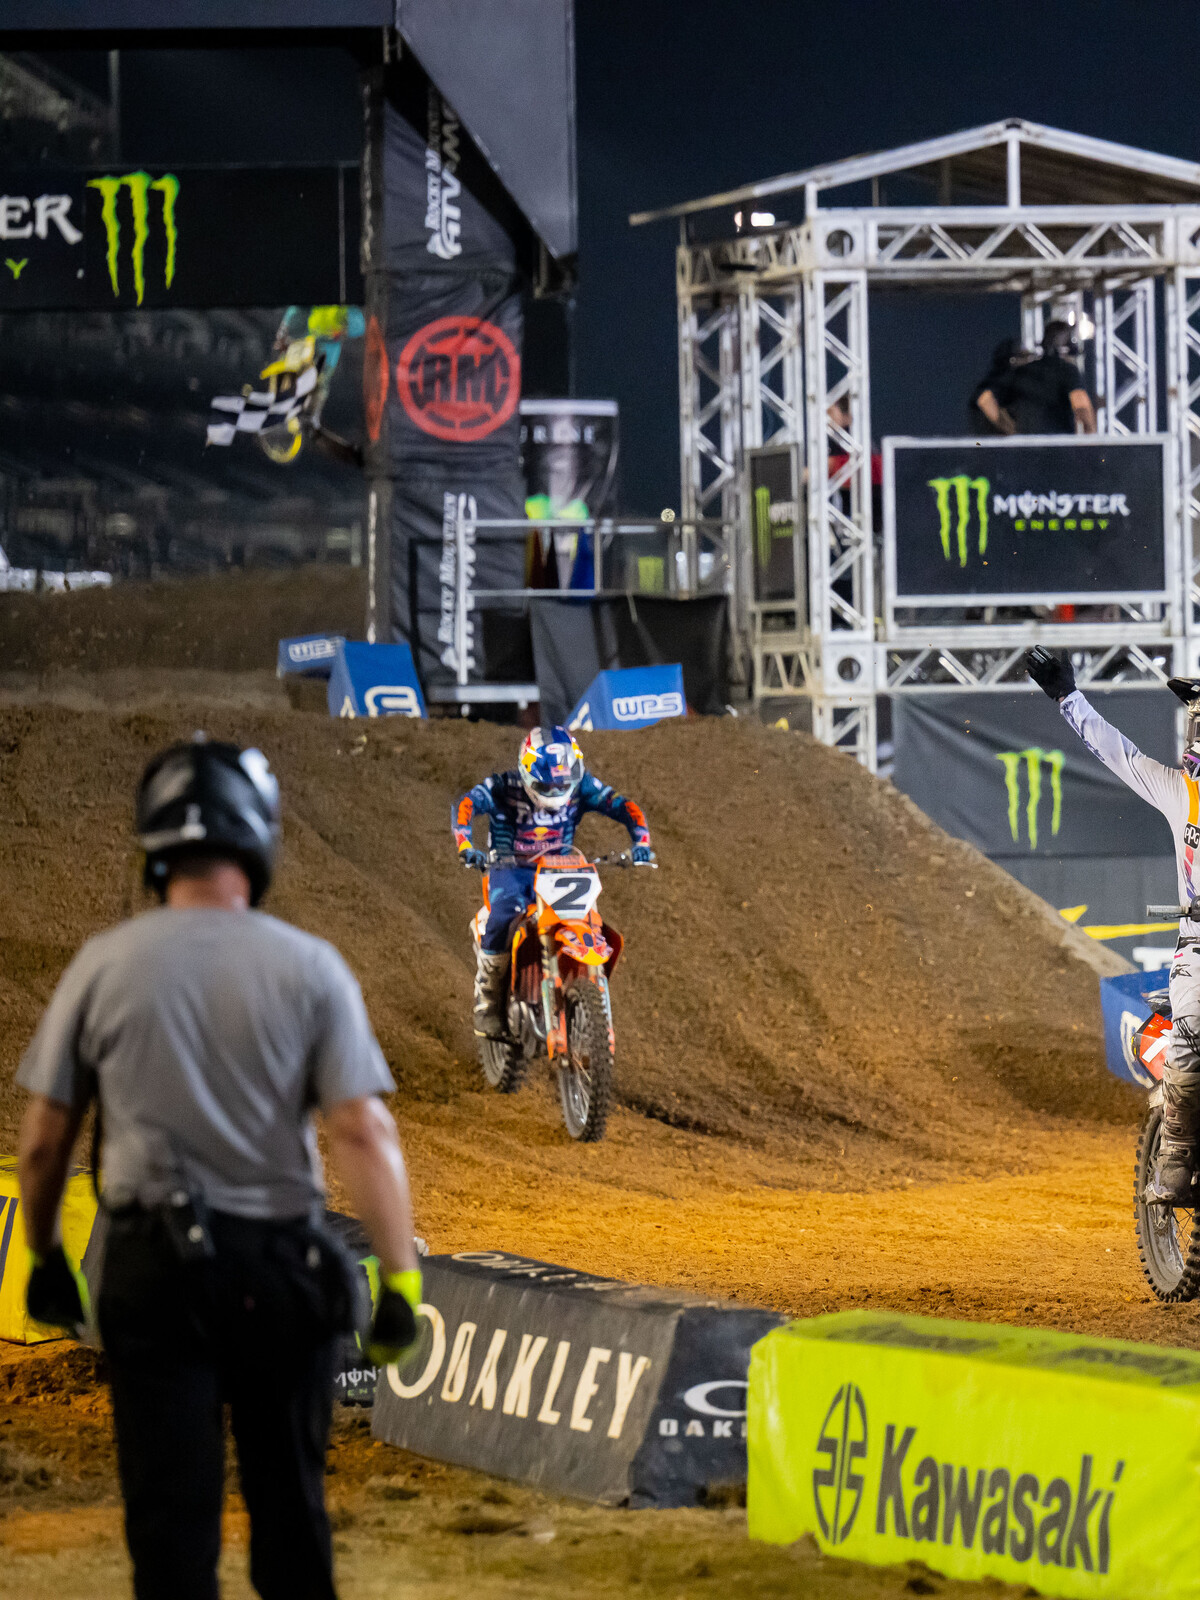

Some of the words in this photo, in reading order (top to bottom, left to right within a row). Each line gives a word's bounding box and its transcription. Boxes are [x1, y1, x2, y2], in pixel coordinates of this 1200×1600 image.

[993, 490, 1131, 518] MONSTER
[612, 691, 684, 722] WPS
[1184, 826, 1200, 845] PPG
[551, 876, 592, 911] 2
[876, 1423, 1125, 1575] Kawasaki
